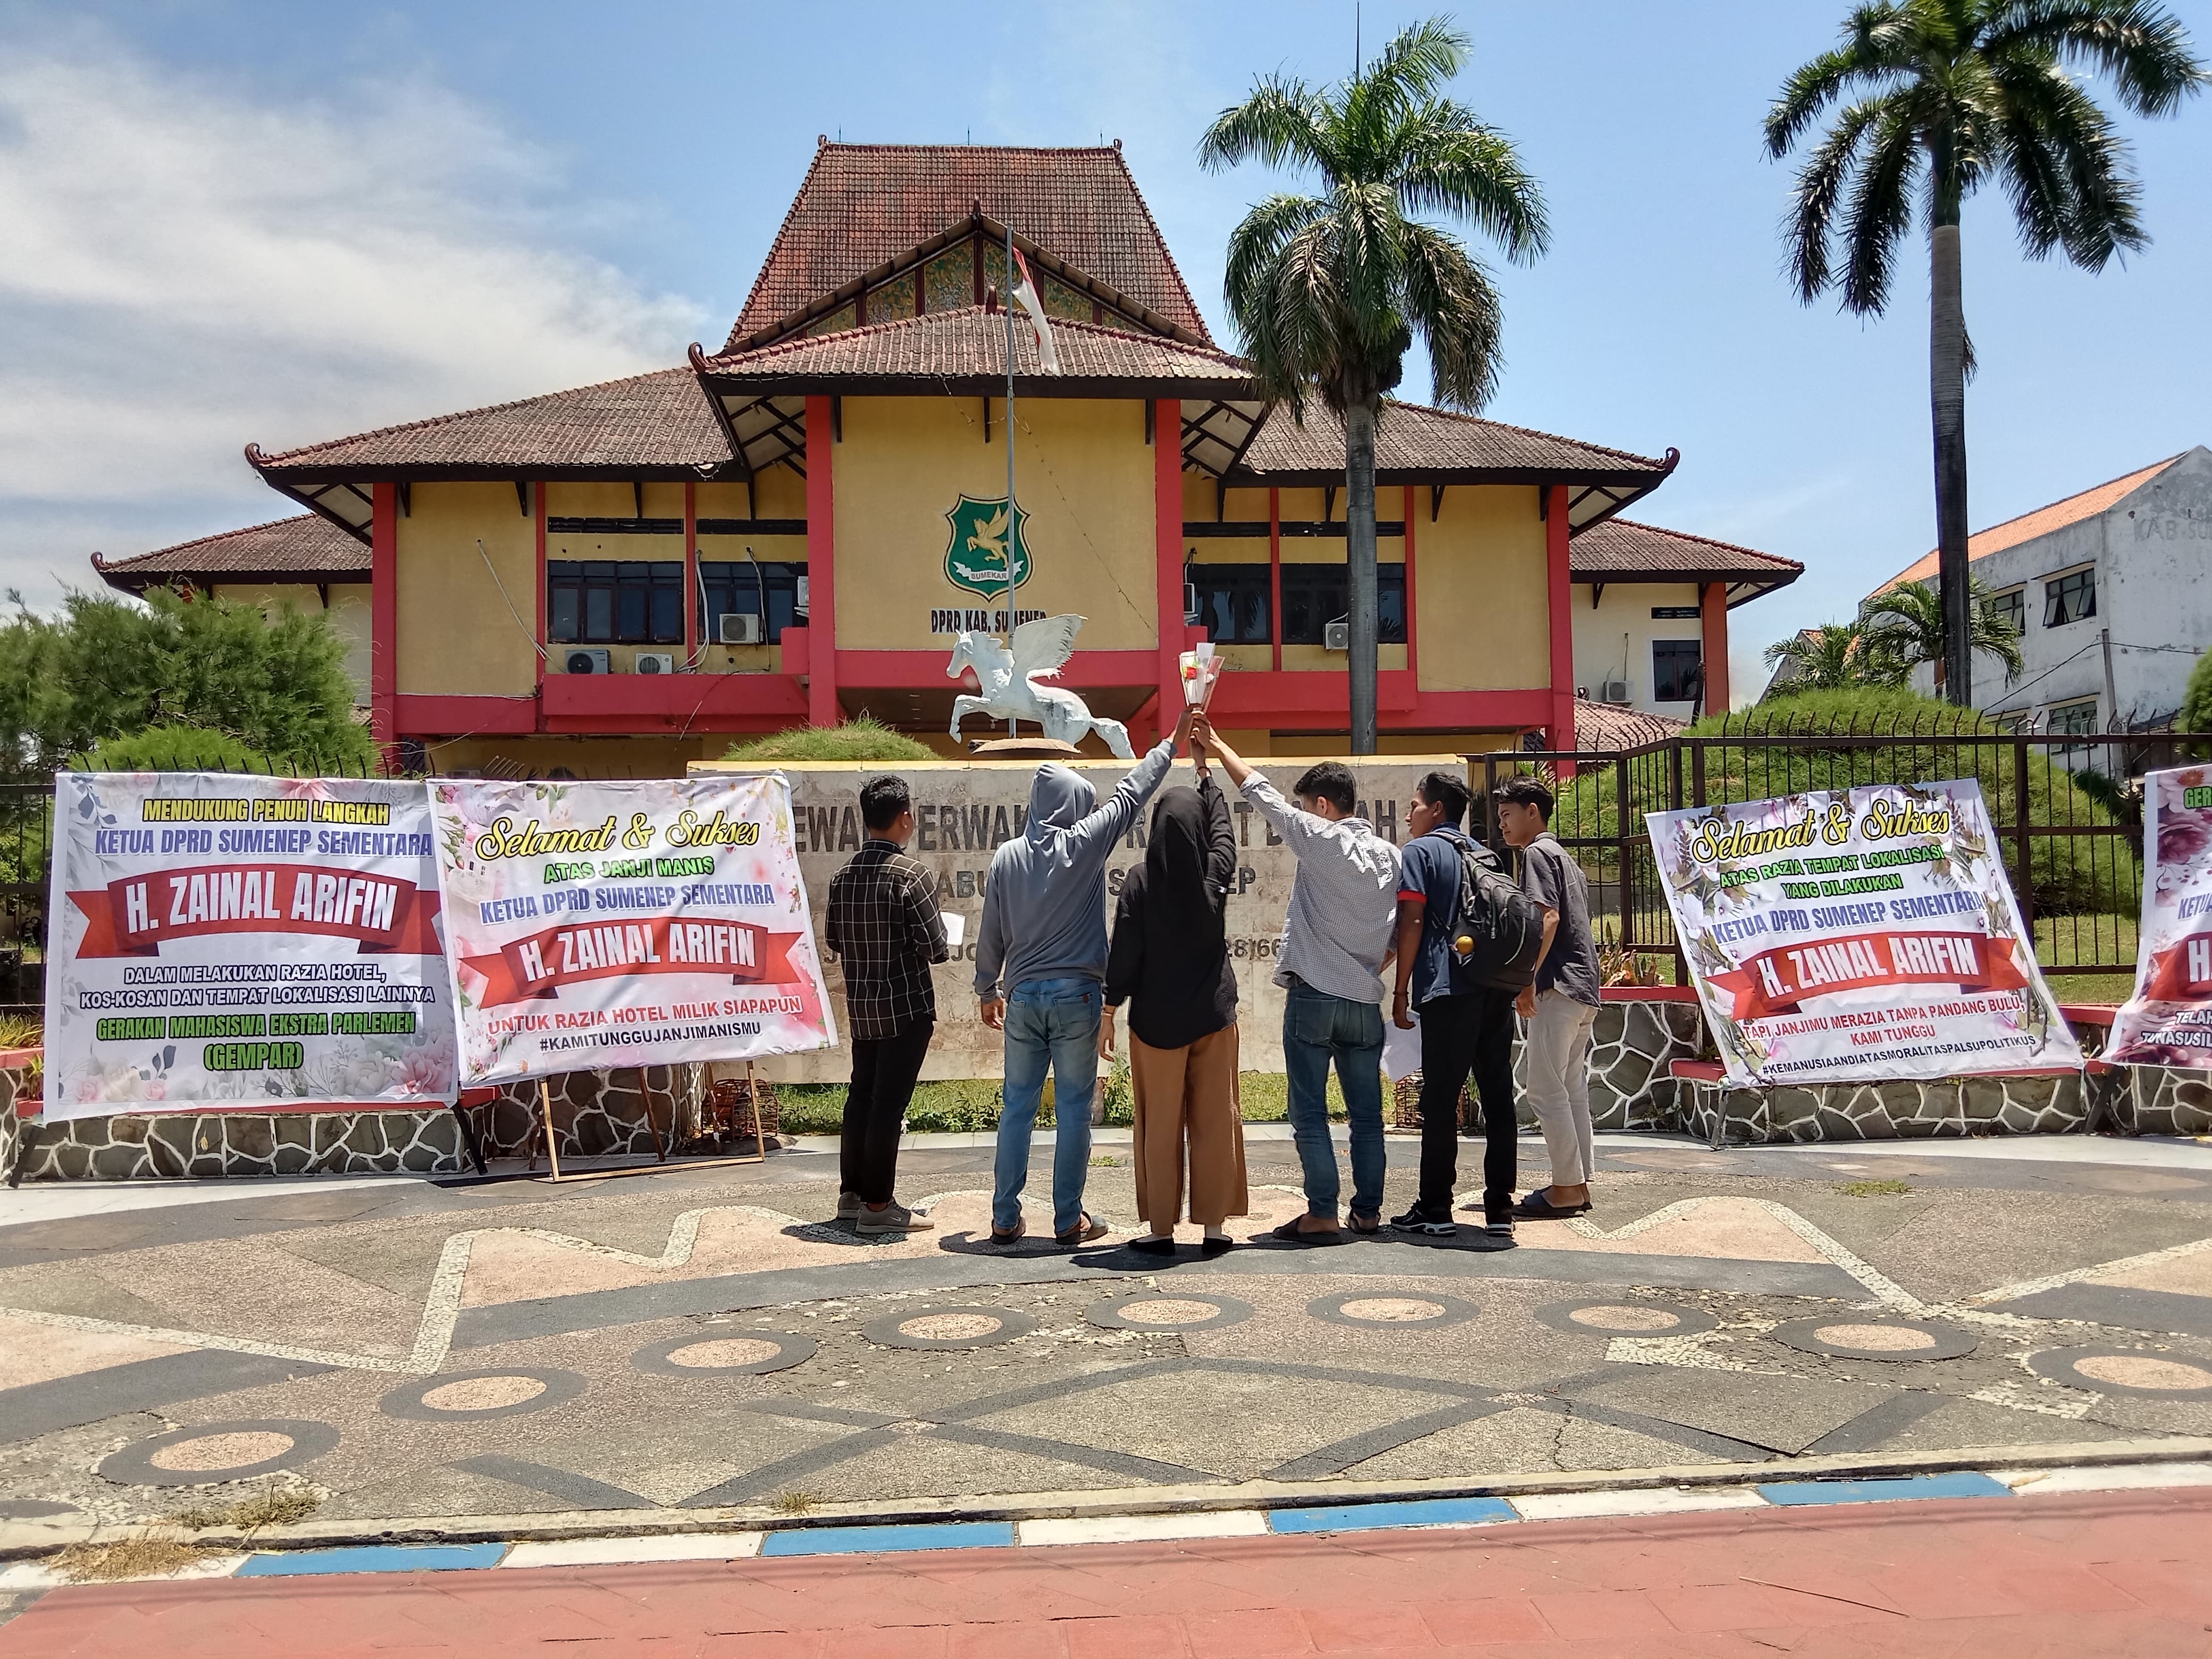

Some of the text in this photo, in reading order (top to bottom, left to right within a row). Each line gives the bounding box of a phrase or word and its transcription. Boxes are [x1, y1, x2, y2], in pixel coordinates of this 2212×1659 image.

[931, 610, 961, 632] DPRD
[966, 610, 991, 633] KAB.
[143, 799, 389, 825] MENDUKUNG PENUH LANGKAH
[95, 829, 433, 857] KETUA DPRD SUMENEP SEMENTARA
[475, 810, 760, 861] Selamat & Sukses
[1692, 798, 1950, 864] Selamat & Sukses
[544, 856, 715, 884] ATAS JANJI MANIS
[1720, 847, 1945, 889] ATAS RAZIA TEMPAT LOKALISASI
[125, 870, 398, 934] H. ZAINAL ARIFIN
[1782, 874, 1903, 900] YANG DILAKUKAN
[480, 883, 775, 926] KETUA DPRD SUMENEP SEMENTARA
[1713, 891, 1984, 945] KETUA DPRD SUMENEP SEMENTARA
[518, 923, 755, 983] H. ZAINAL ARIFIN
[1756, 937, 1980, 999] H. ZAINAL ARIFIN
[124, 963, 387, 985] DALAM MELAKUKAN RAZIA HOTEL,
[80, 986, 435, 1009] KOS-KOSAN DAN TEMPAT LOKALISASI LAINNYA
[96, 1011, 416, 1041] GERAKAN MAHASISWA EKSTRA PARLEMEN
[487, 995, 803, 1036] UNTUK RAZIA HOTEL MILIK SIAPAPUN
[1743, 995, 2026, 1039] TAPI JANJIMU MERAZIA TANPA PANDANG BULU,
[539, 1021, 762, 1052] #KAMITUNGGUJANJIMANISMU
[1850, 1025, 1937, 1047] KAMI TUNGGU
[2141, 1032, 2212, 1048] TUNASUSIL
[204, 1042, 303, 1071] (GEMPAR)
